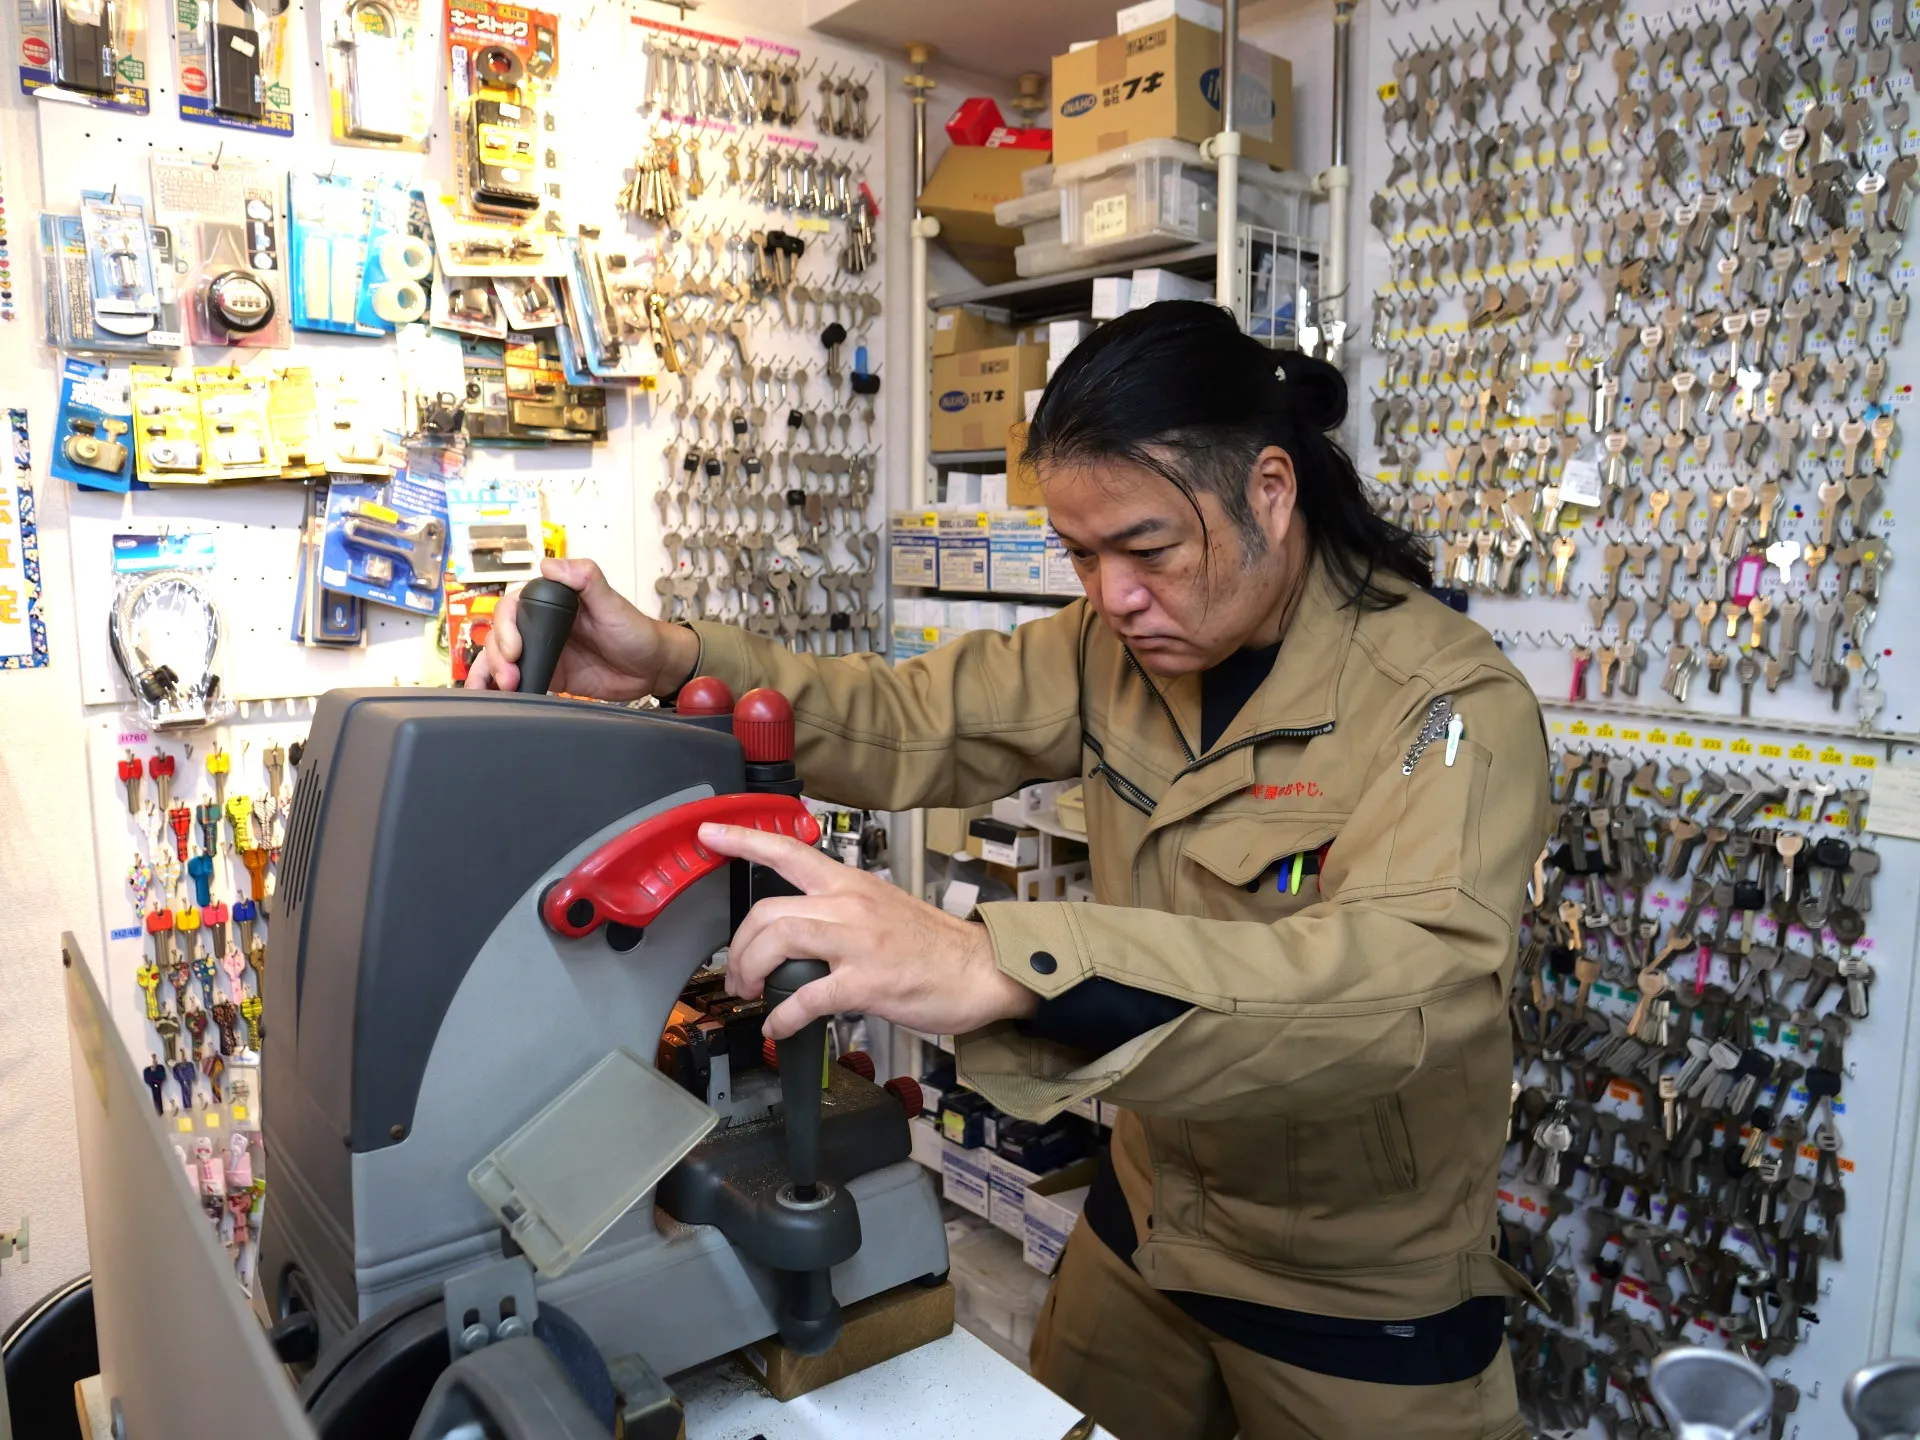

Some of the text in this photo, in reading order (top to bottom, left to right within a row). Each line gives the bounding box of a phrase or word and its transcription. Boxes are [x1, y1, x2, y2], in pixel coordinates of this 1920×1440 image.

[450, 9, 529, 37] キーストック
[1122, 70, 1165, 101] フキ
[1878, 519, 1896, 527] 185
[121, 733, 147, 742] H760
